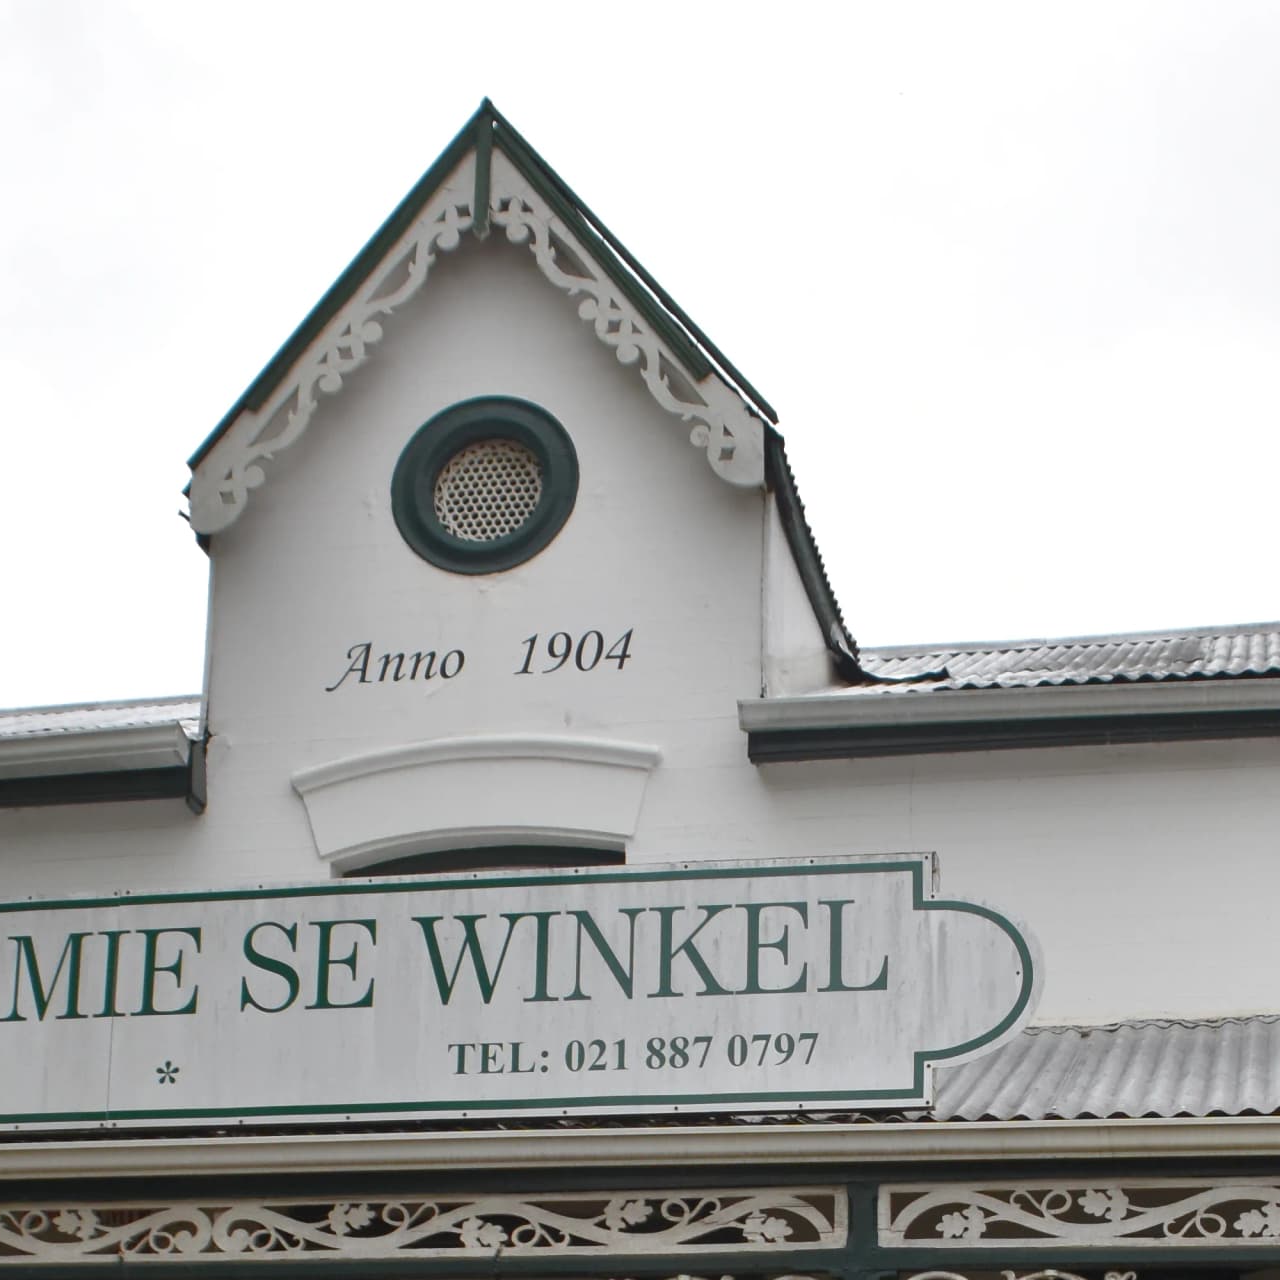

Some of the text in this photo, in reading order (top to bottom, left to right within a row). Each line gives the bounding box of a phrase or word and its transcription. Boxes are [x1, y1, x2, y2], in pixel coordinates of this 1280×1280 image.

[325, 627, 634, 692] Anno 1904
[239, 918, 378, 1013] SE
[410, 899, 889, 1006] WINKEL
[447, 1031, 820, 1075] TEL: 021 887 0797
